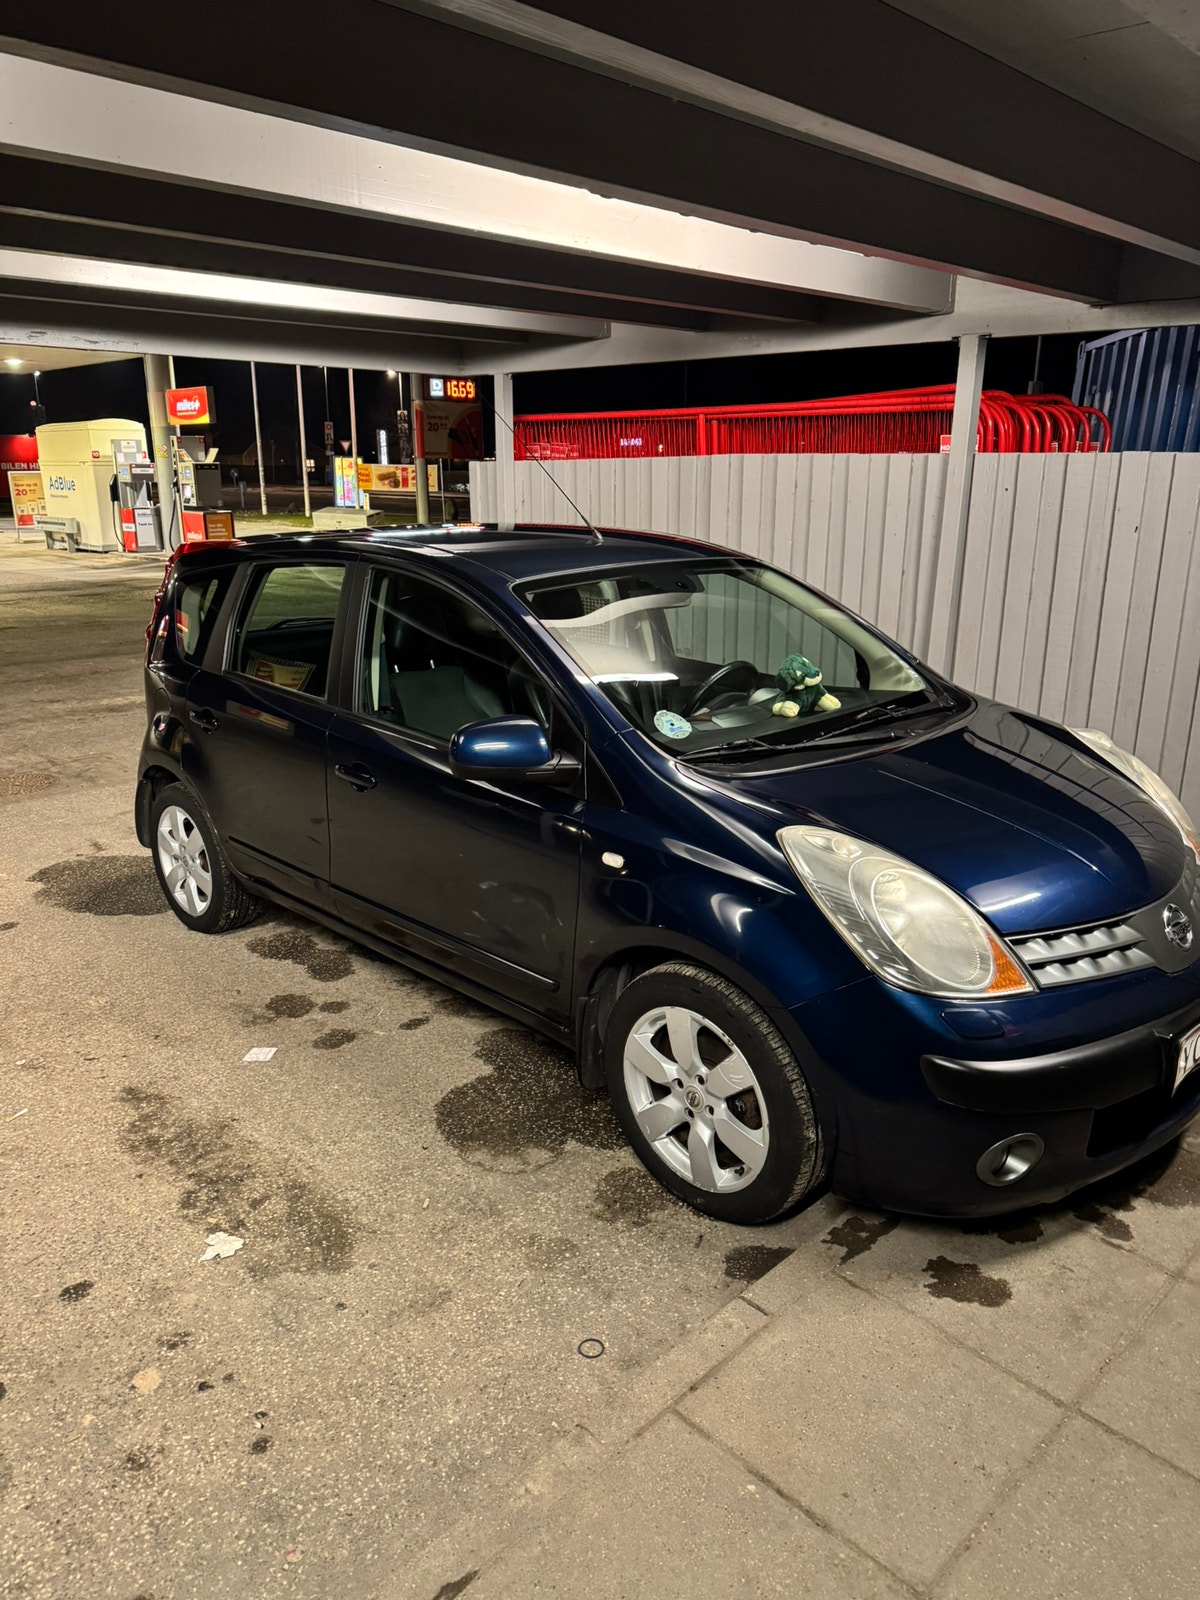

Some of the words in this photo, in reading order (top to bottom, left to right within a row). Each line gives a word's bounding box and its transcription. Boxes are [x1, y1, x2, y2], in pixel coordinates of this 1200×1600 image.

[447, 380, 475, 399] 16.69
[427, 422, 439, 432] 20
[1, 462, 27, 470] BILEN
[49, 476, 76, 491] AdBlue
[15, 488, 28, 496] 20
